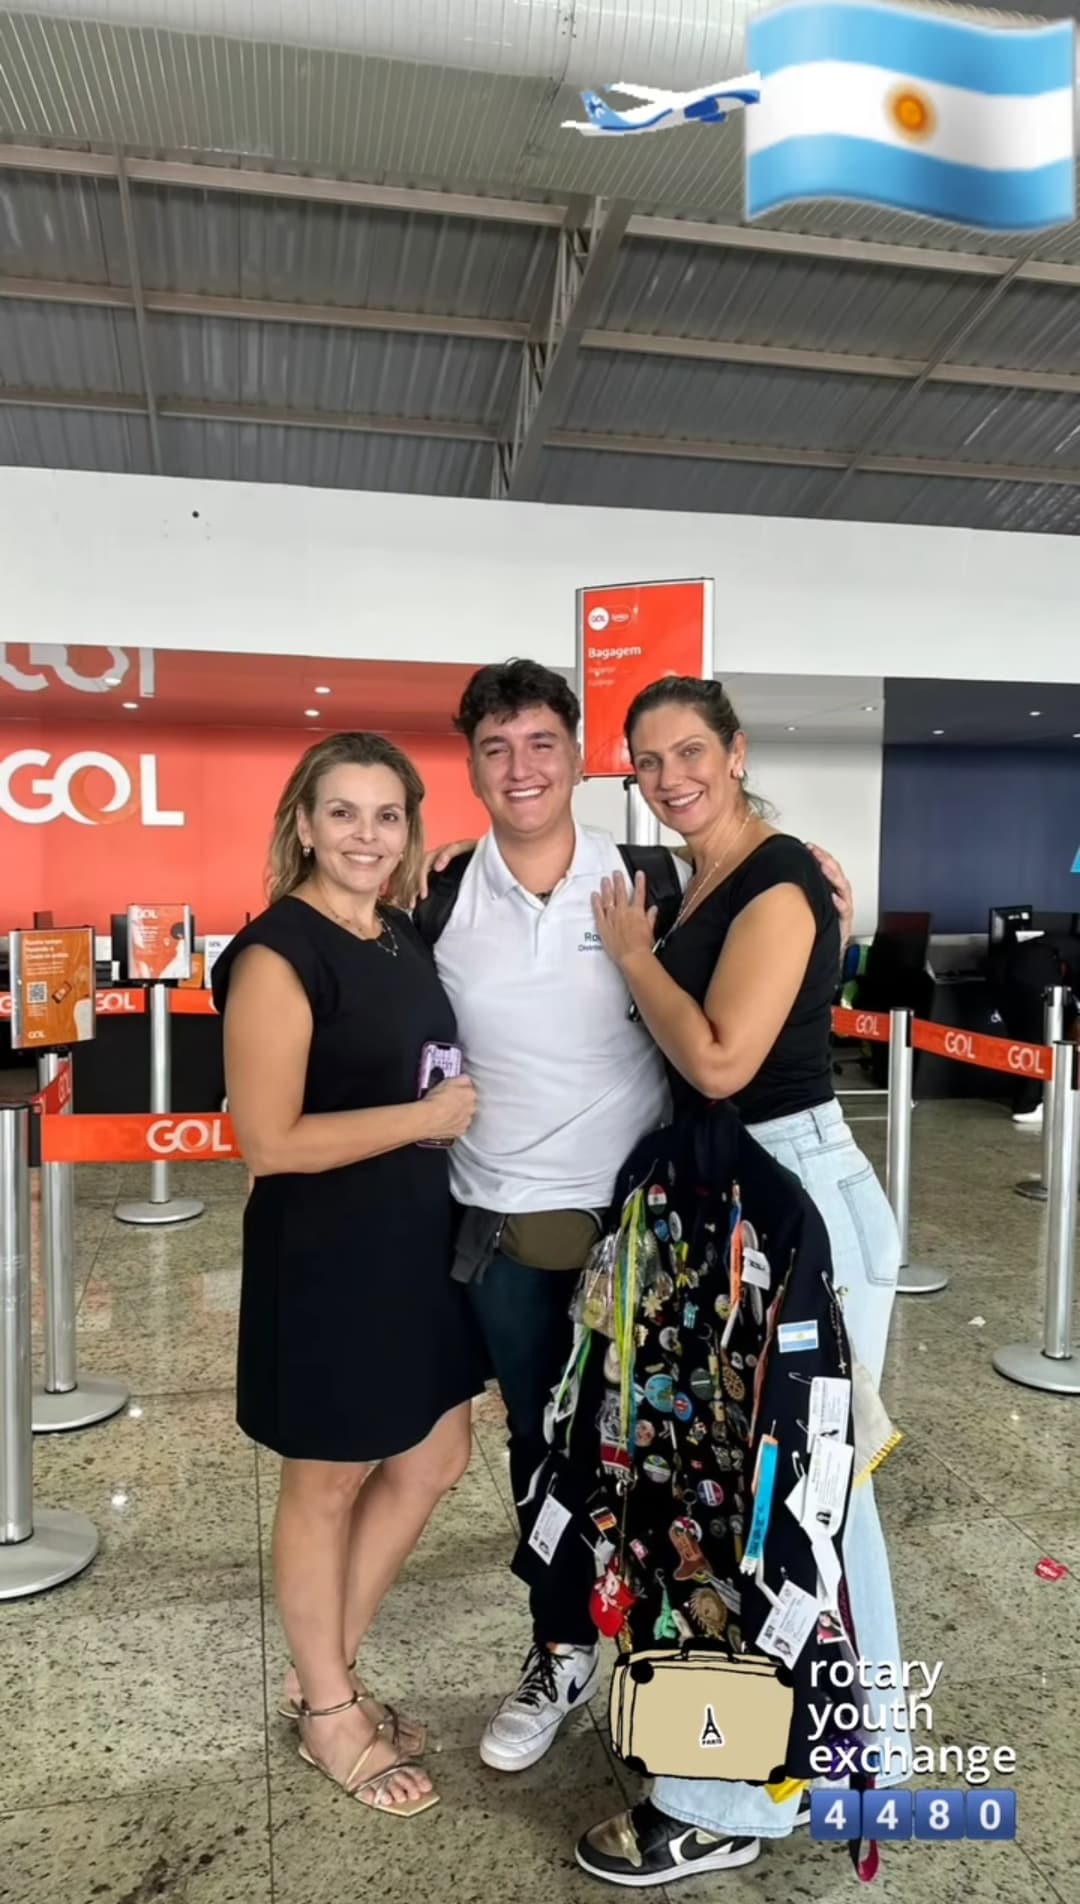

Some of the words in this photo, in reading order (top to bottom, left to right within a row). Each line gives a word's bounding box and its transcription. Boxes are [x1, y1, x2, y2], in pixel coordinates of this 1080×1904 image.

[588, 646, 642, 659] Bagagem
[0, 748, 185, 826] GOL
[855, 1014, 880, 1036] GOL
[944, 1032, 976, 1059] GOL
[1008, 1046, 1045, 1074] GOL
[147, 1119, 232, 1154] GOL
